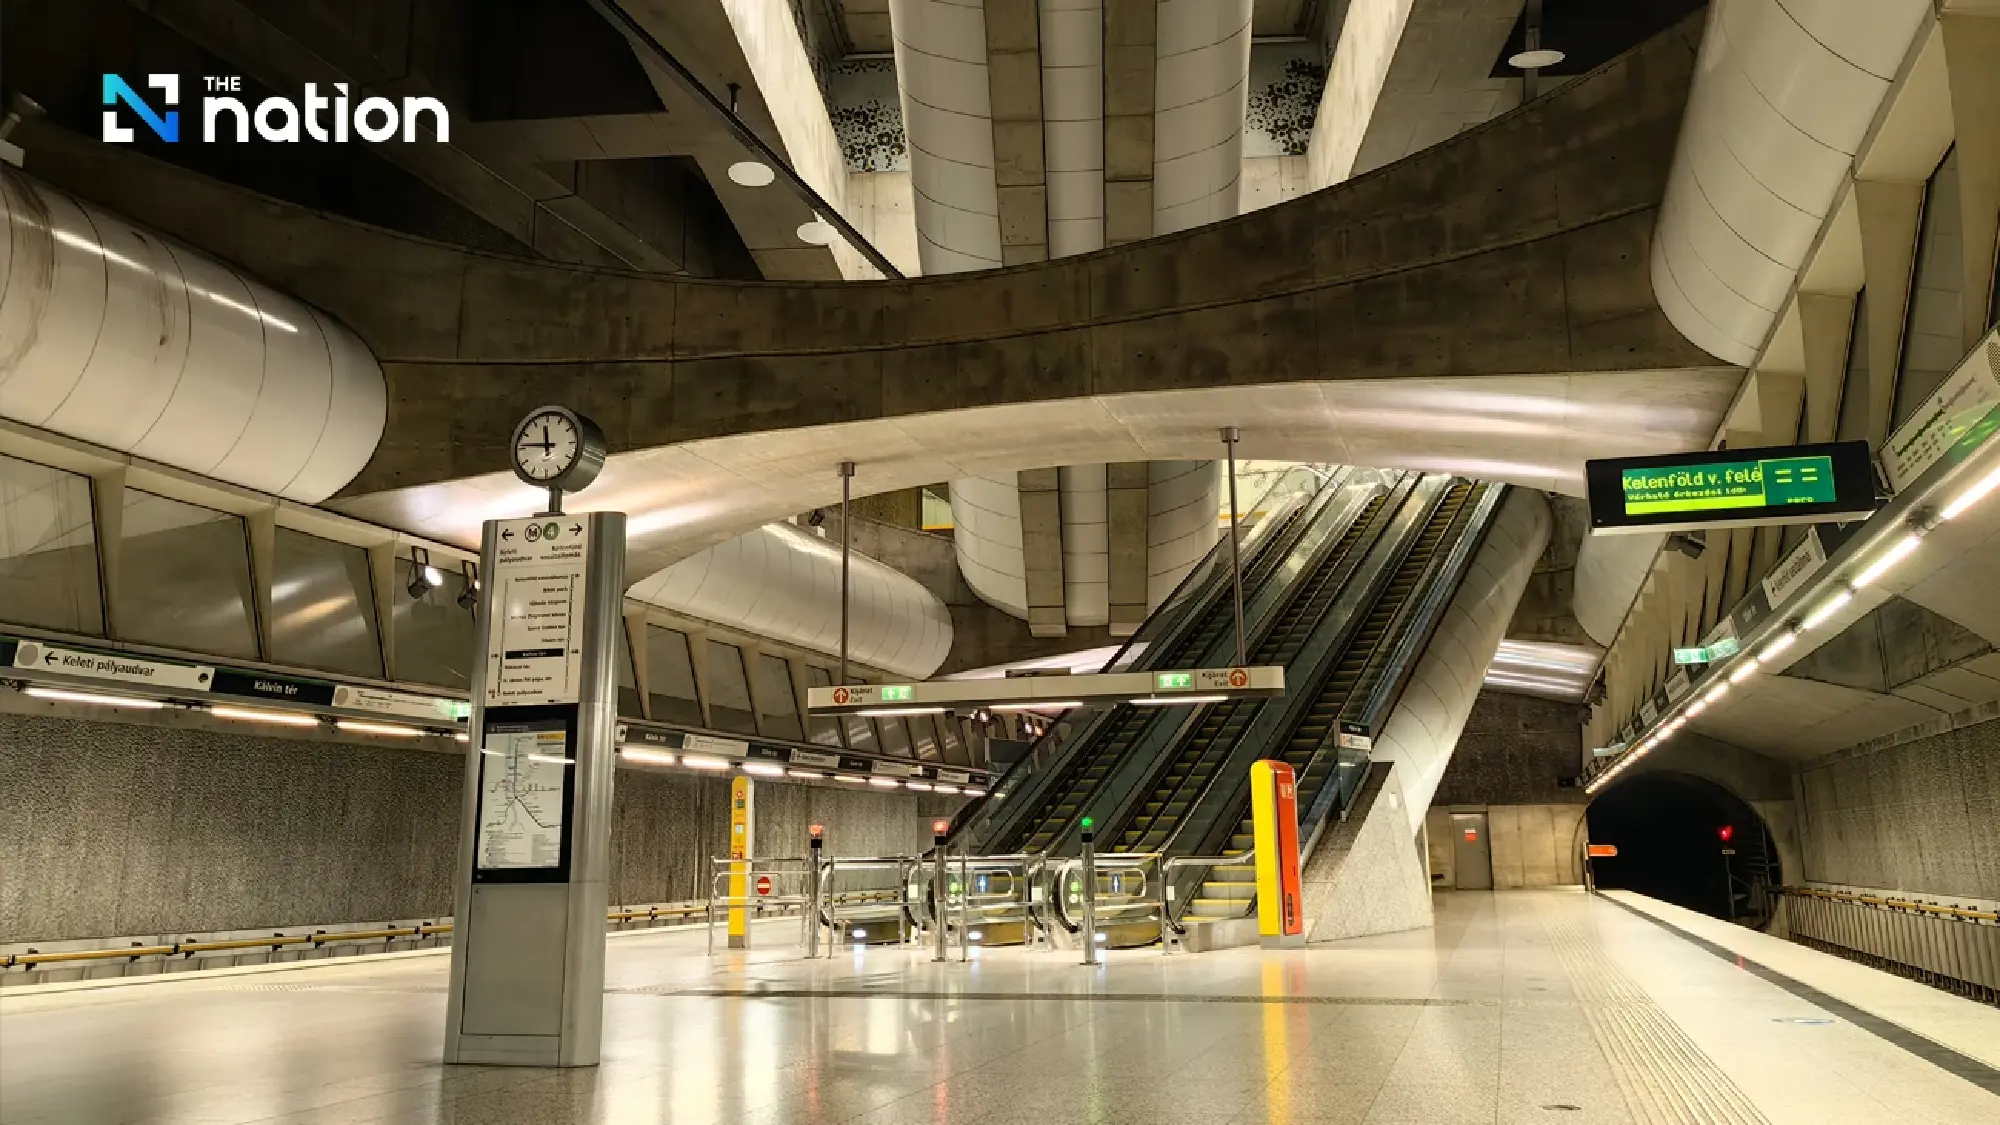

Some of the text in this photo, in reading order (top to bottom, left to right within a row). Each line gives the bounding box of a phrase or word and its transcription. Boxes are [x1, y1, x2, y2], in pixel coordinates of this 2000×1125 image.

[1622, 466, 1762, 490] Kelenföld v. felé
[63, 655, 155, 677] Keleti pályaudvar
